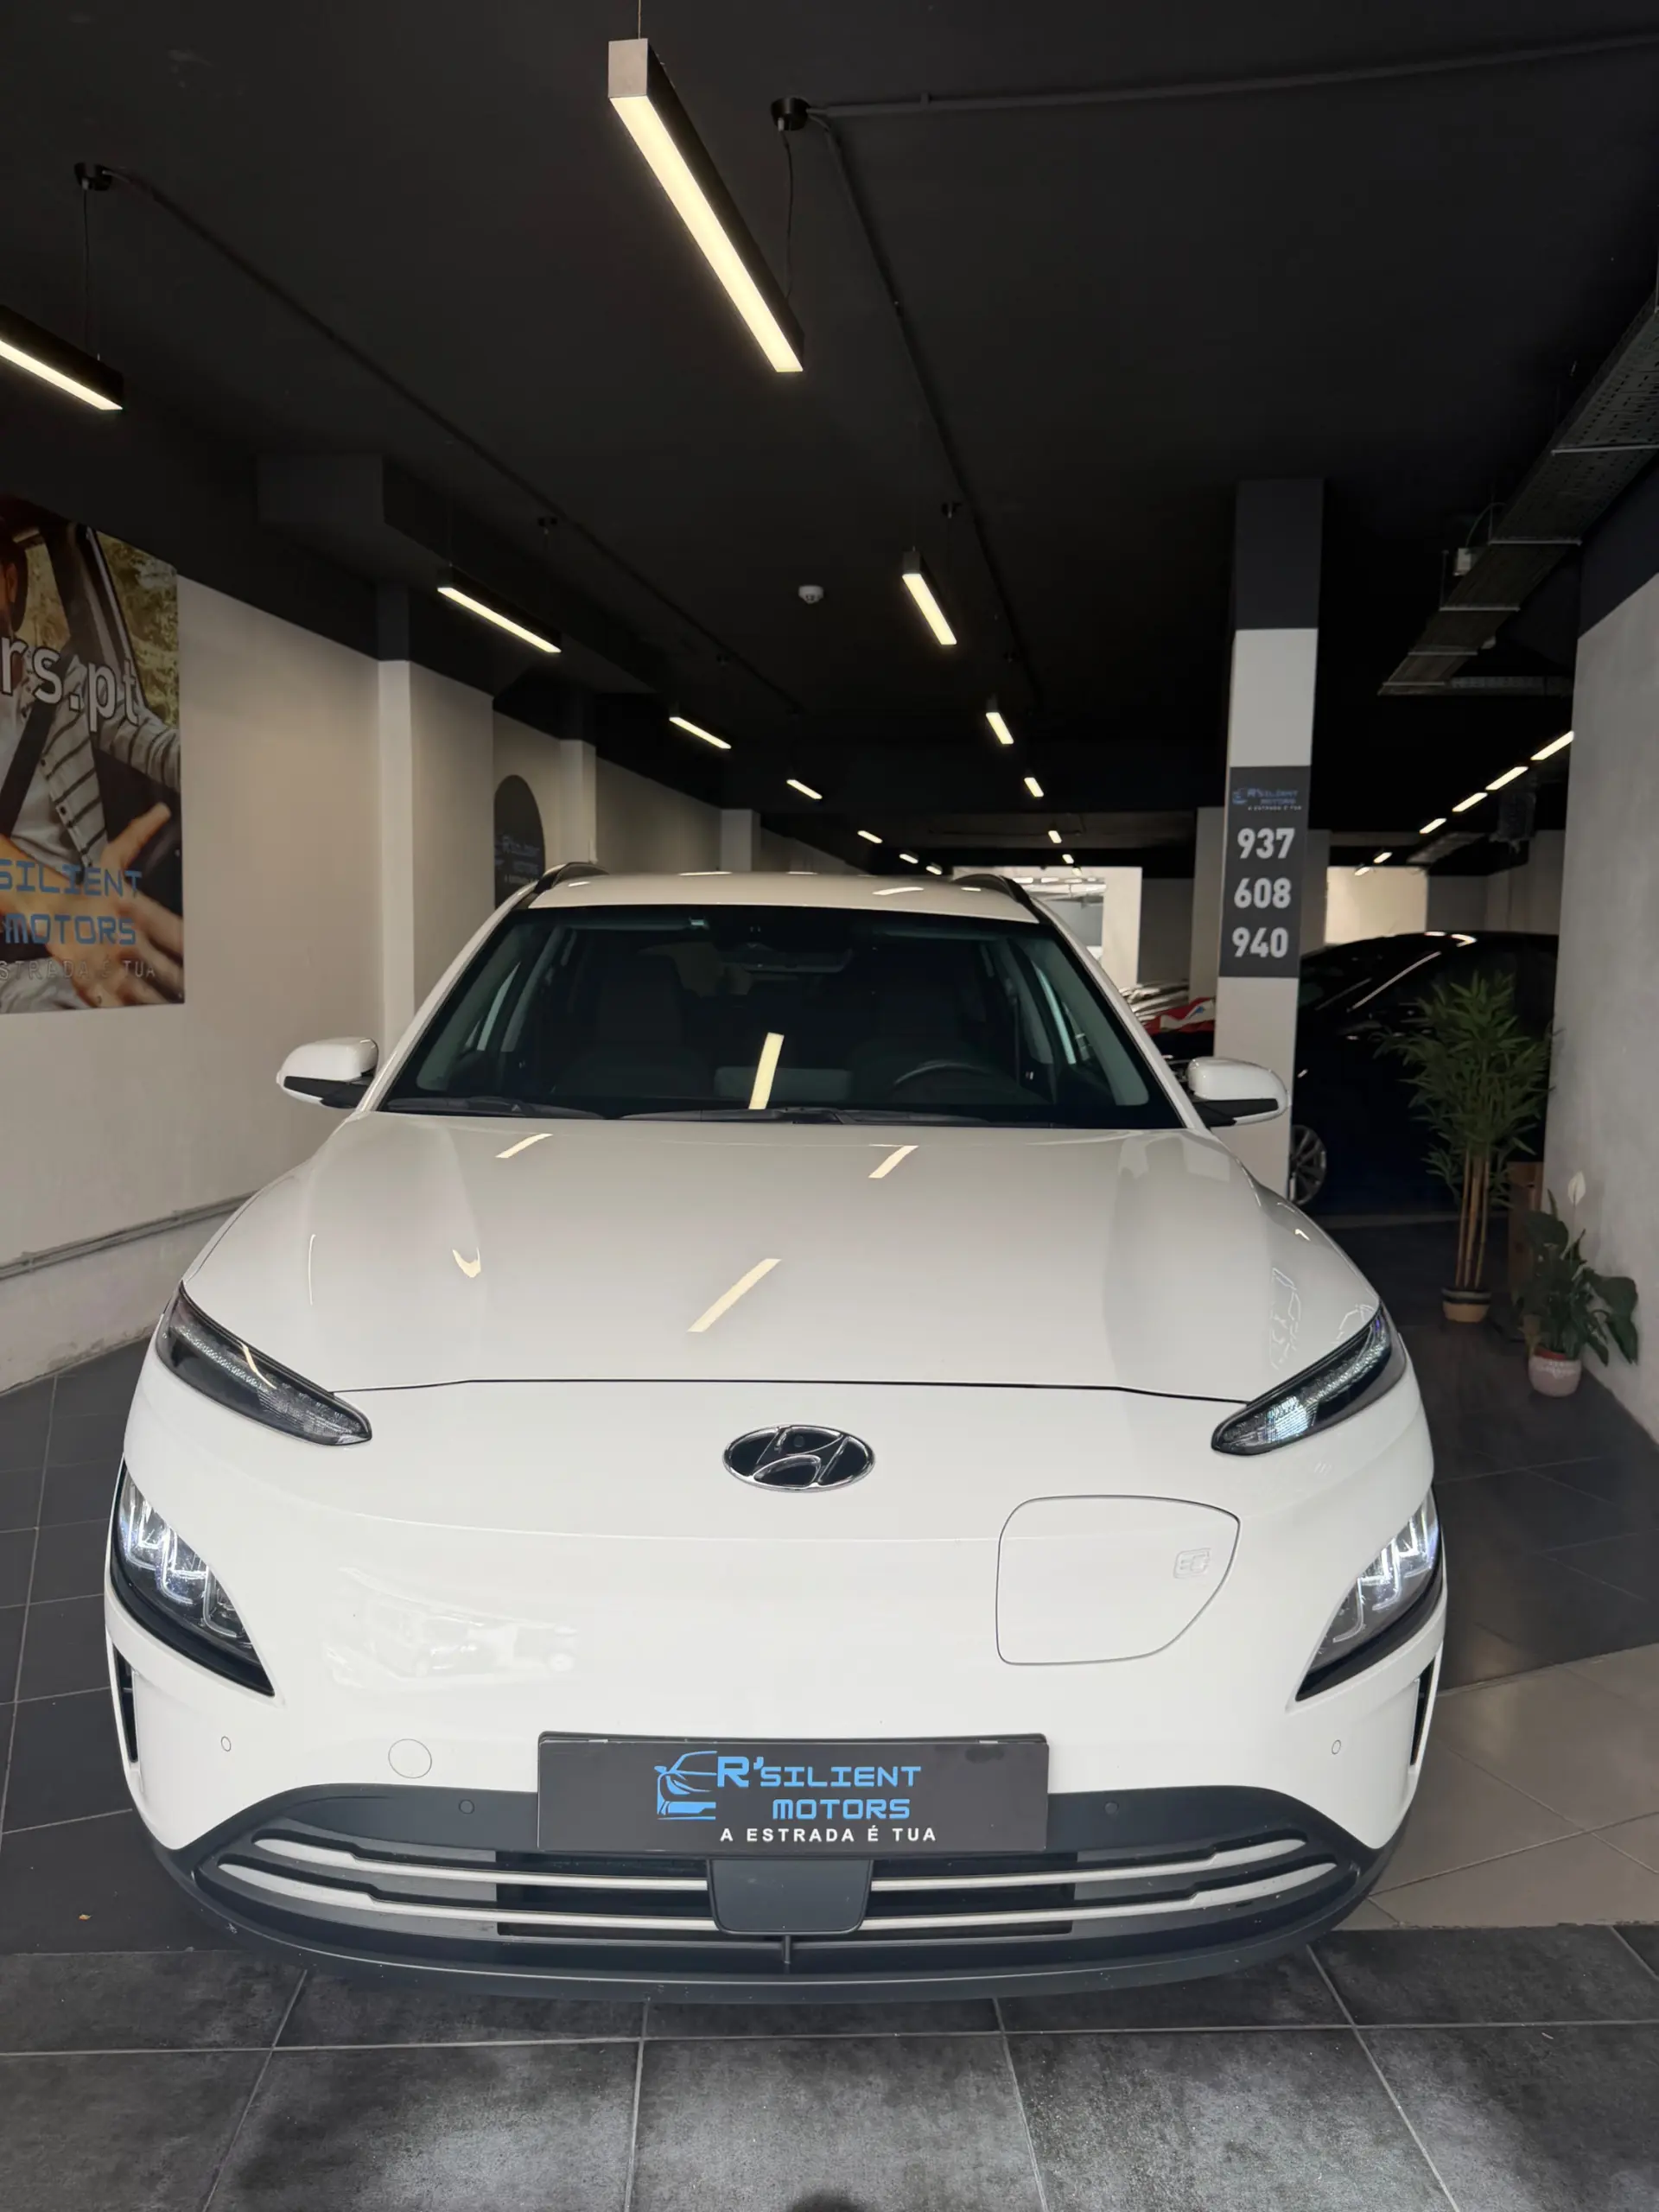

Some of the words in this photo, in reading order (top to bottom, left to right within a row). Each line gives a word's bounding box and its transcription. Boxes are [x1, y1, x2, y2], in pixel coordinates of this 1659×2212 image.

[1, 636, 139, 734] rs.pt
[1237, 828, 1295, 859] 937
[1234, 877, 1292, 909] 608
[5, 912, 136, 945] MOTORS
[1231, 927, 1289, 958] 940
[124, 960, 156, 978] TUA
[772, 1798, 911, 1820] MOTORS
[720, 1828, 734, 1842] A
[747, 1827, 855, 1842] ESTRADA
[868, 1824, 879, 1842] É
[893, 1827, 936, 1841] TUA
